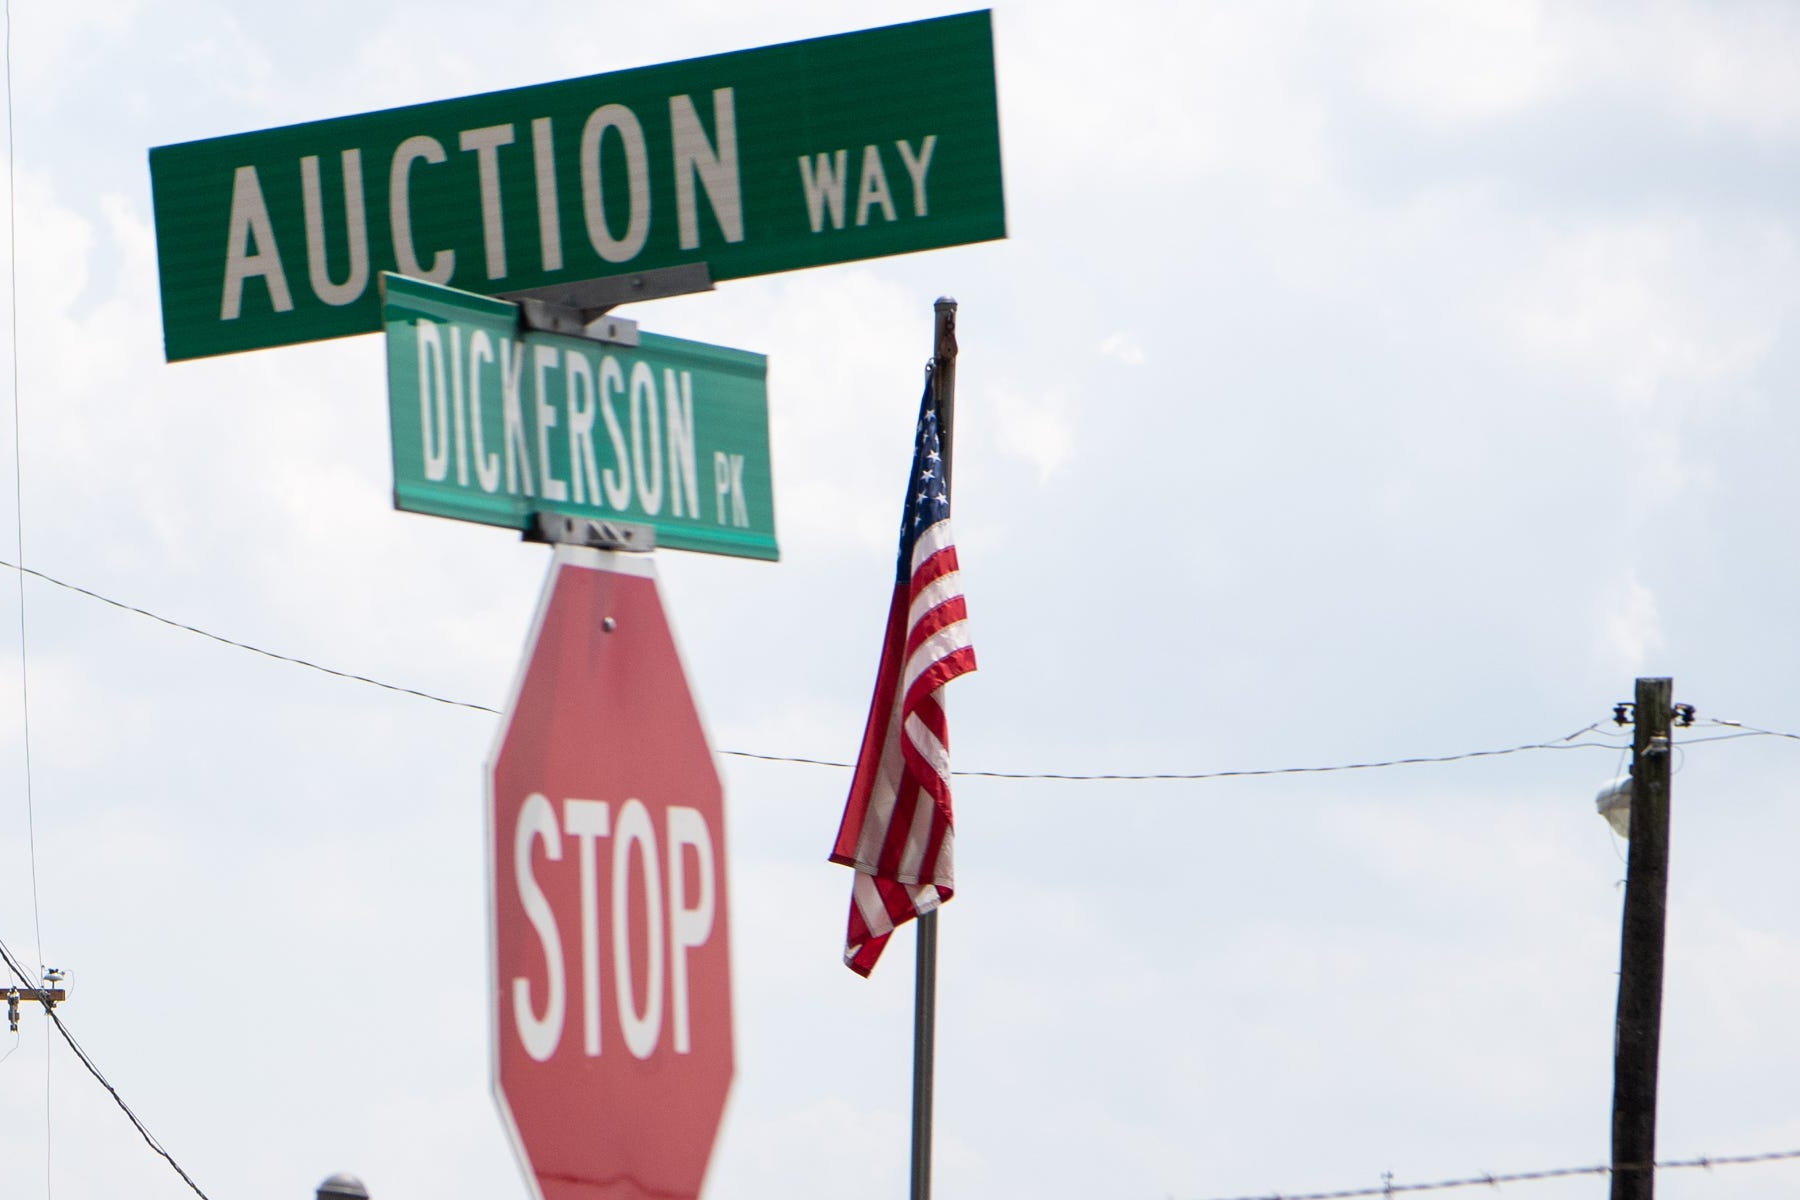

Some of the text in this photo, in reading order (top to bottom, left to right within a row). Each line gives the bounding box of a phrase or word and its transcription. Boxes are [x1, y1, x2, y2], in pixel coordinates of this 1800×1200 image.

[219, 86, 938, 322] AUCTION WAY
[415, 318, 749, 529] DICKERSON PK
[512, 792, 716, 1062] STOP
